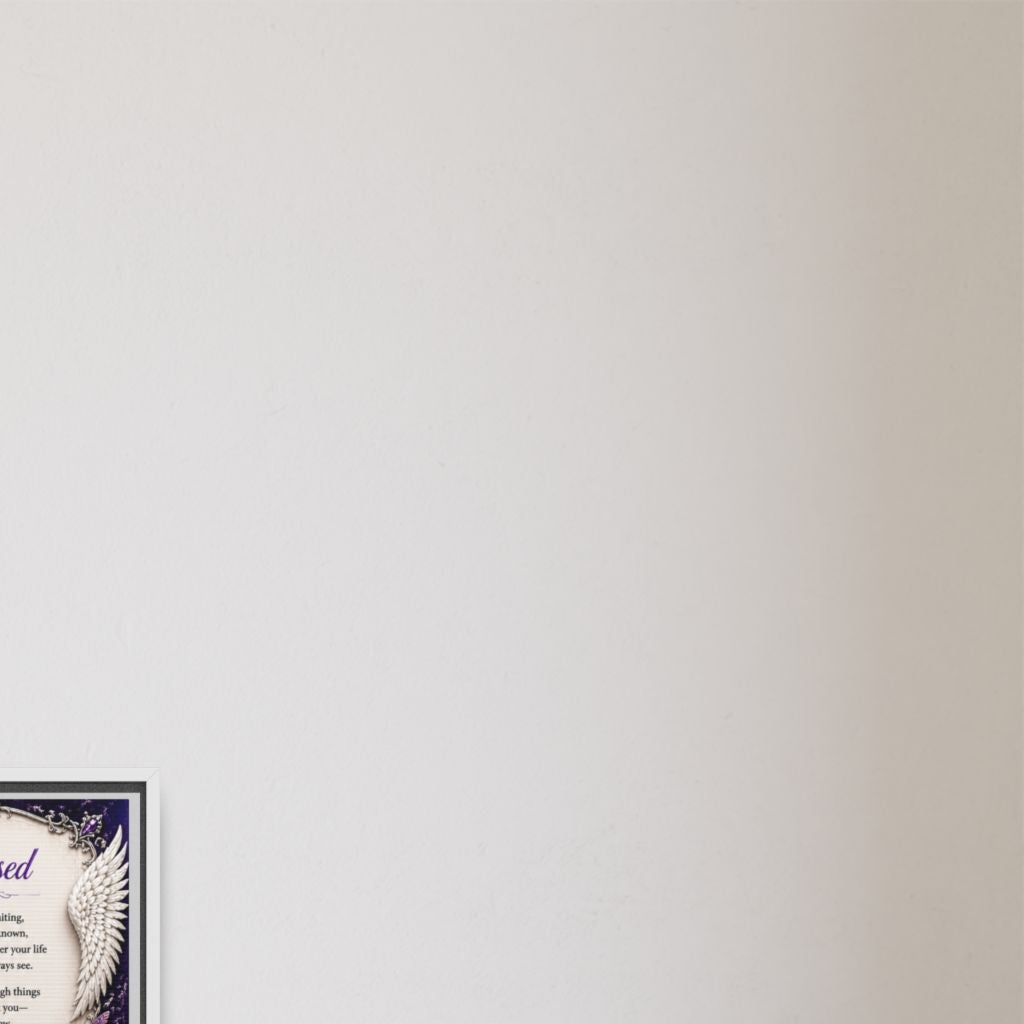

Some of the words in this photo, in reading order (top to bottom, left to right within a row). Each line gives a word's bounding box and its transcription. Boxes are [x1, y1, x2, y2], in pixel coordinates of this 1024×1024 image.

[10, 946, 31, 956] your
[33, 944, 48, 954] life
[13, 987, 41, 999] things
